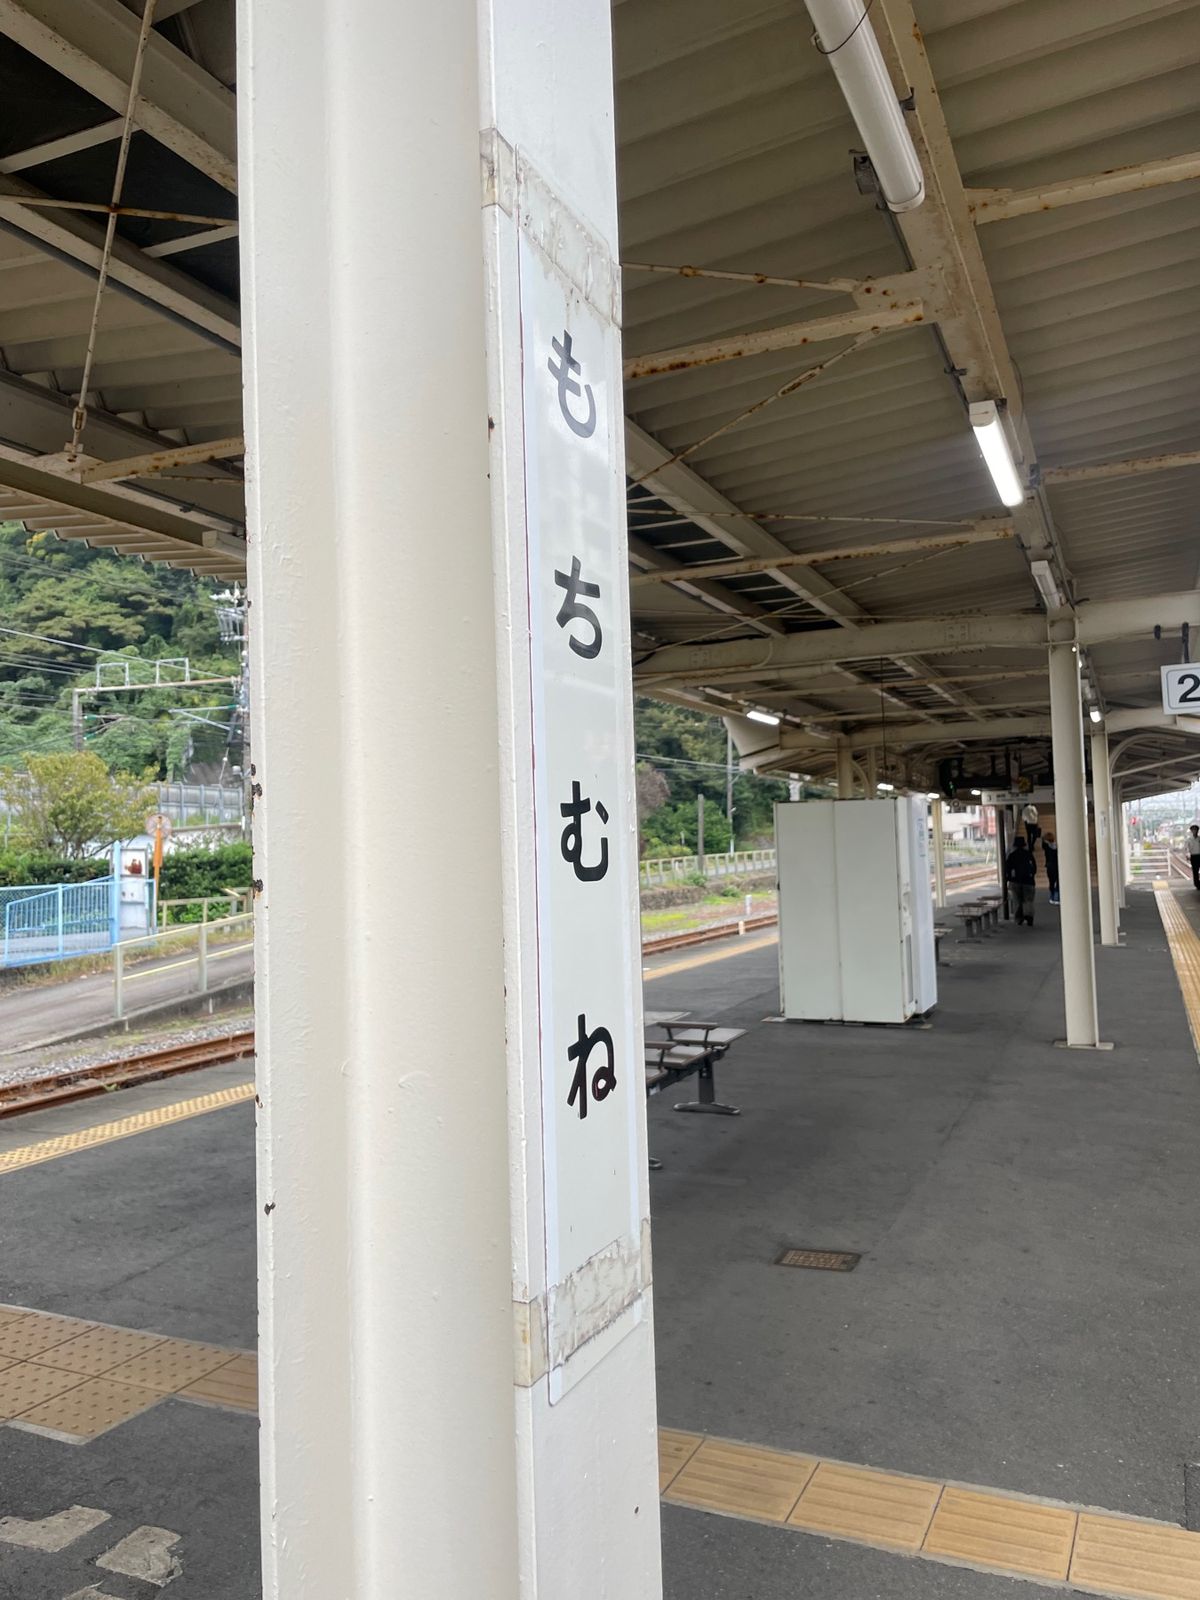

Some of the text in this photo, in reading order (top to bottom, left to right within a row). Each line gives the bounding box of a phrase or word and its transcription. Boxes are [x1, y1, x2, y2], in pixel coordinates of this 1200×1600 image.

[548, 329, 617, 1120] もちむね
[1177, 673, 1200, 703] 2
